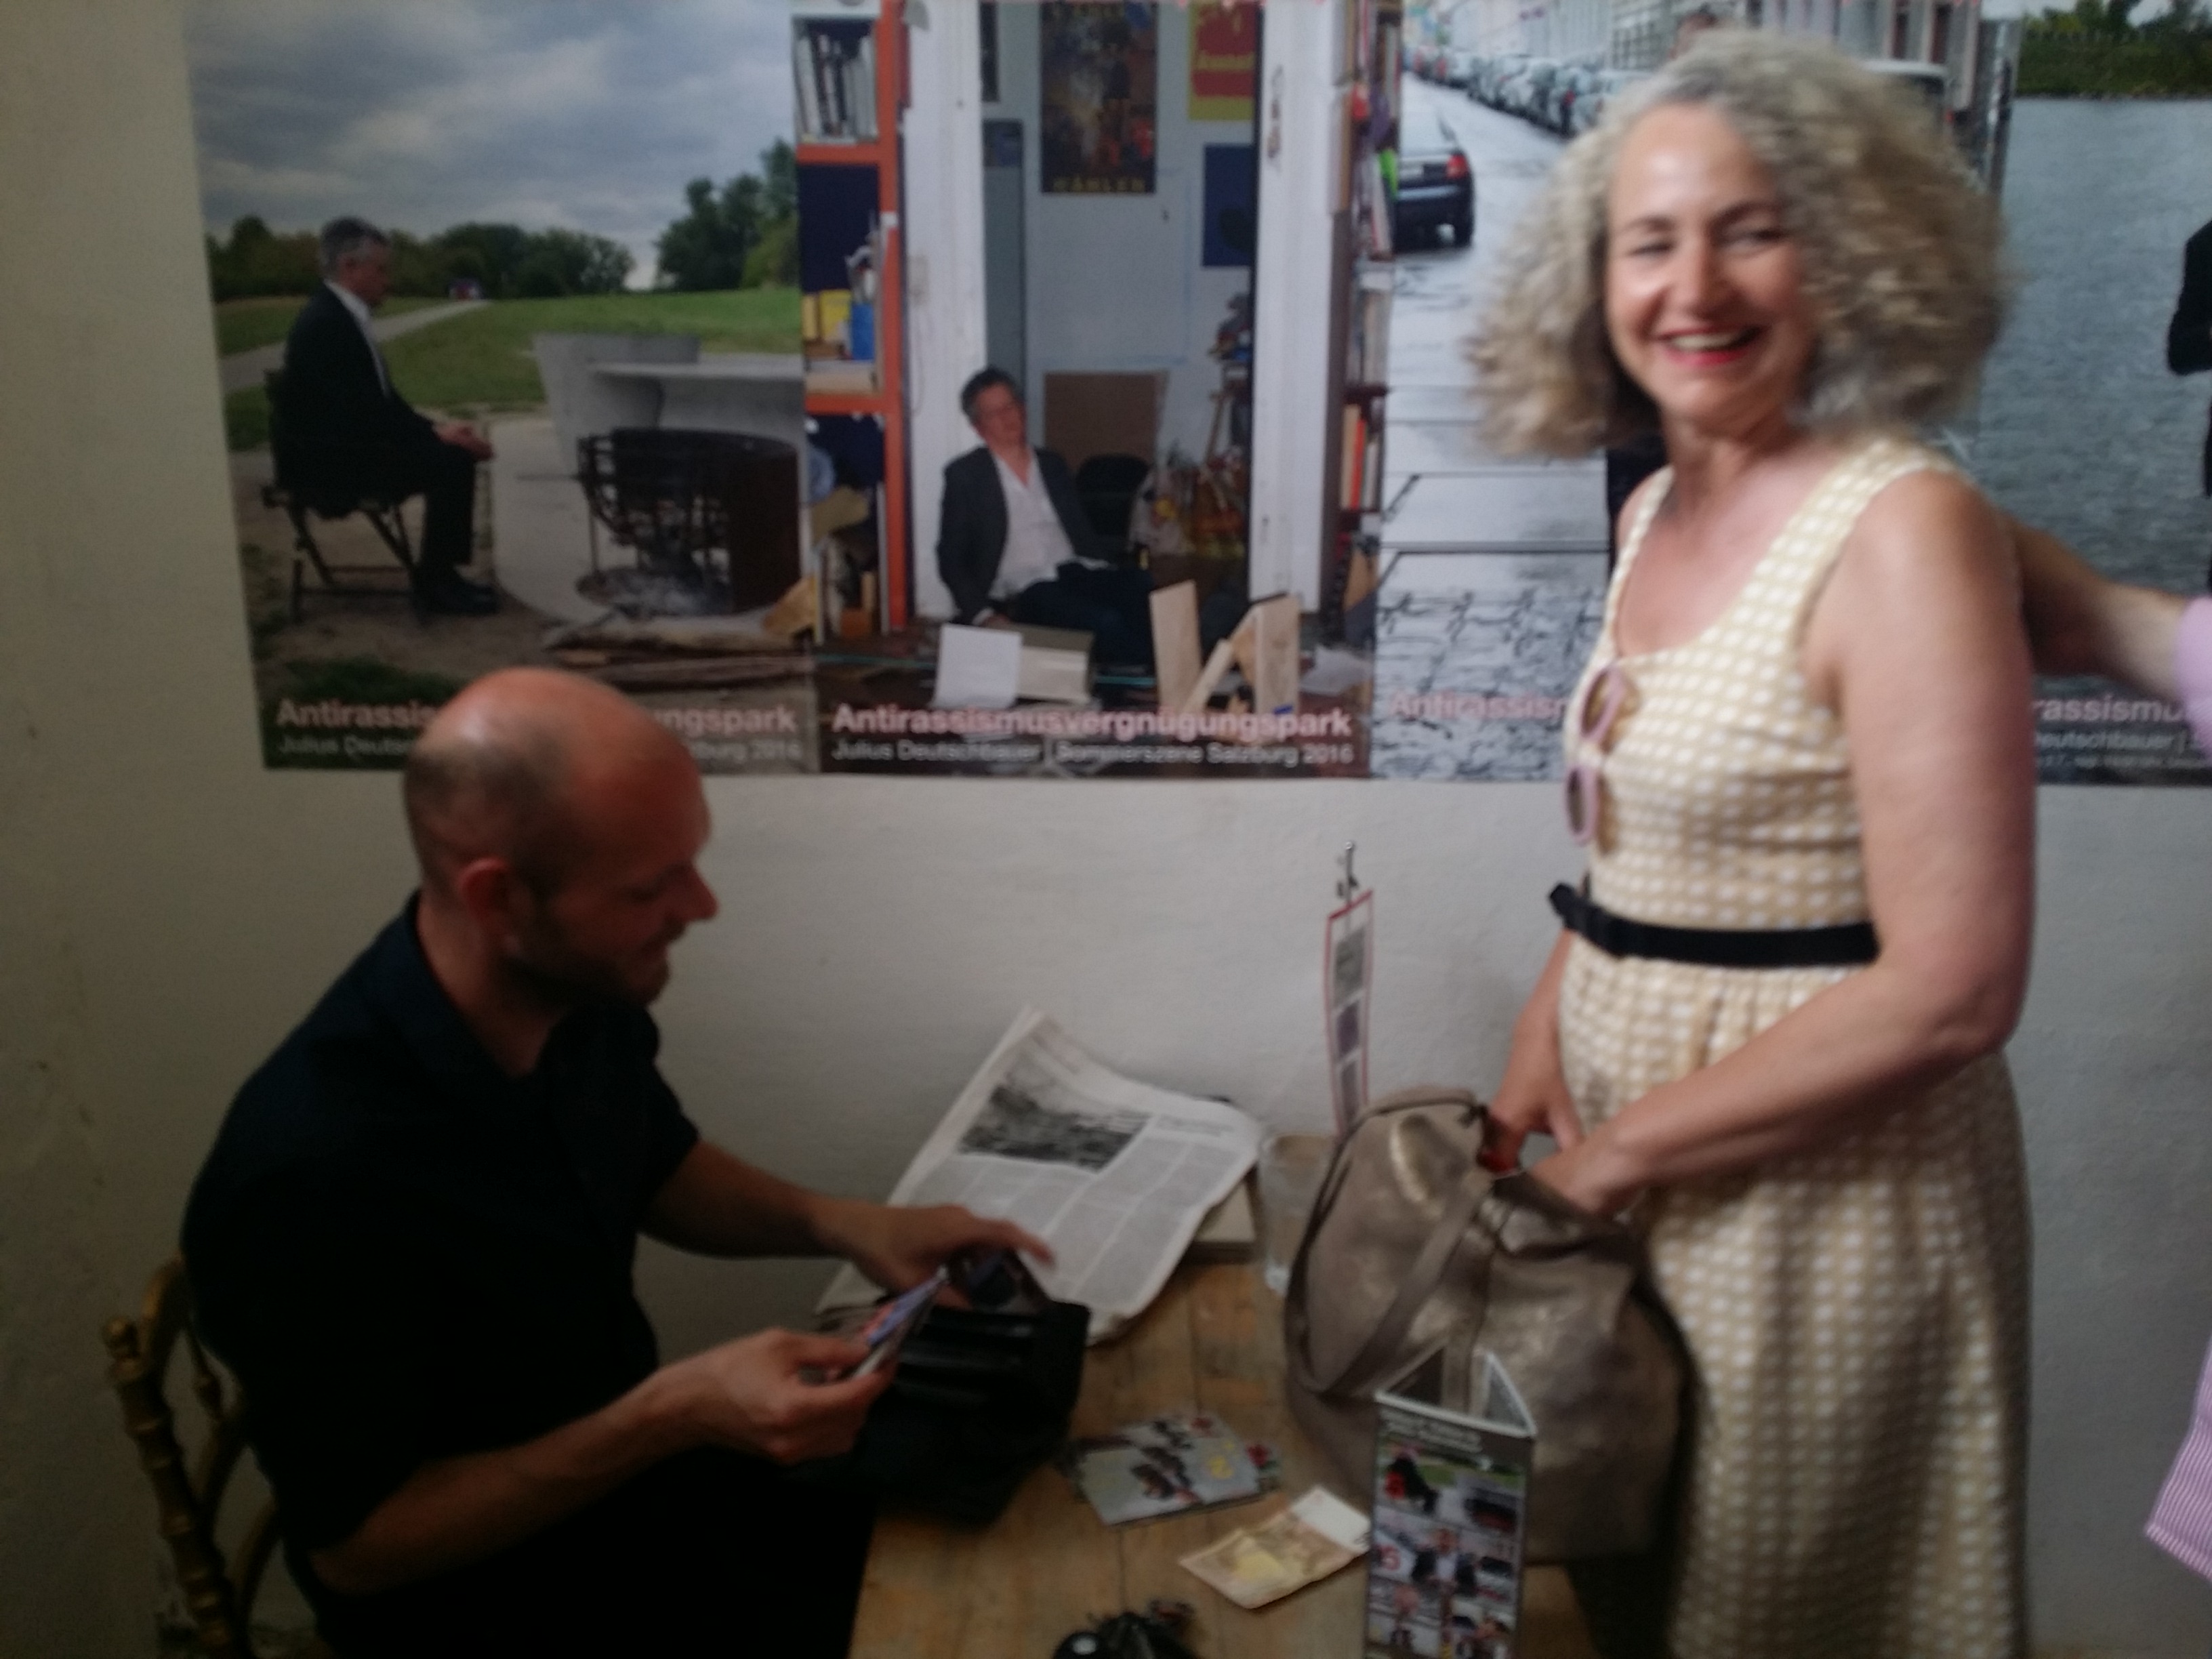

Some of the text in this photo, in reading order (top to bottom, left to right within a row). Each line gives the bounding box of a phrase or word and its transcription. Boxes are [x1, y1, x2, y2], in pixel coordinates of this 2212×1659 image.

[832, 702, 1353, 743] Antirassismusvergnügungspark
[831, 739, 894, 761] Julius
[1054, 741, 1204, 765] Sommerszene
[1206, 742, 1299, 769] Salzburg
[1303, 744, 1354, 764] 2016
[2035, 732, 2174, 750] eutschbauer
